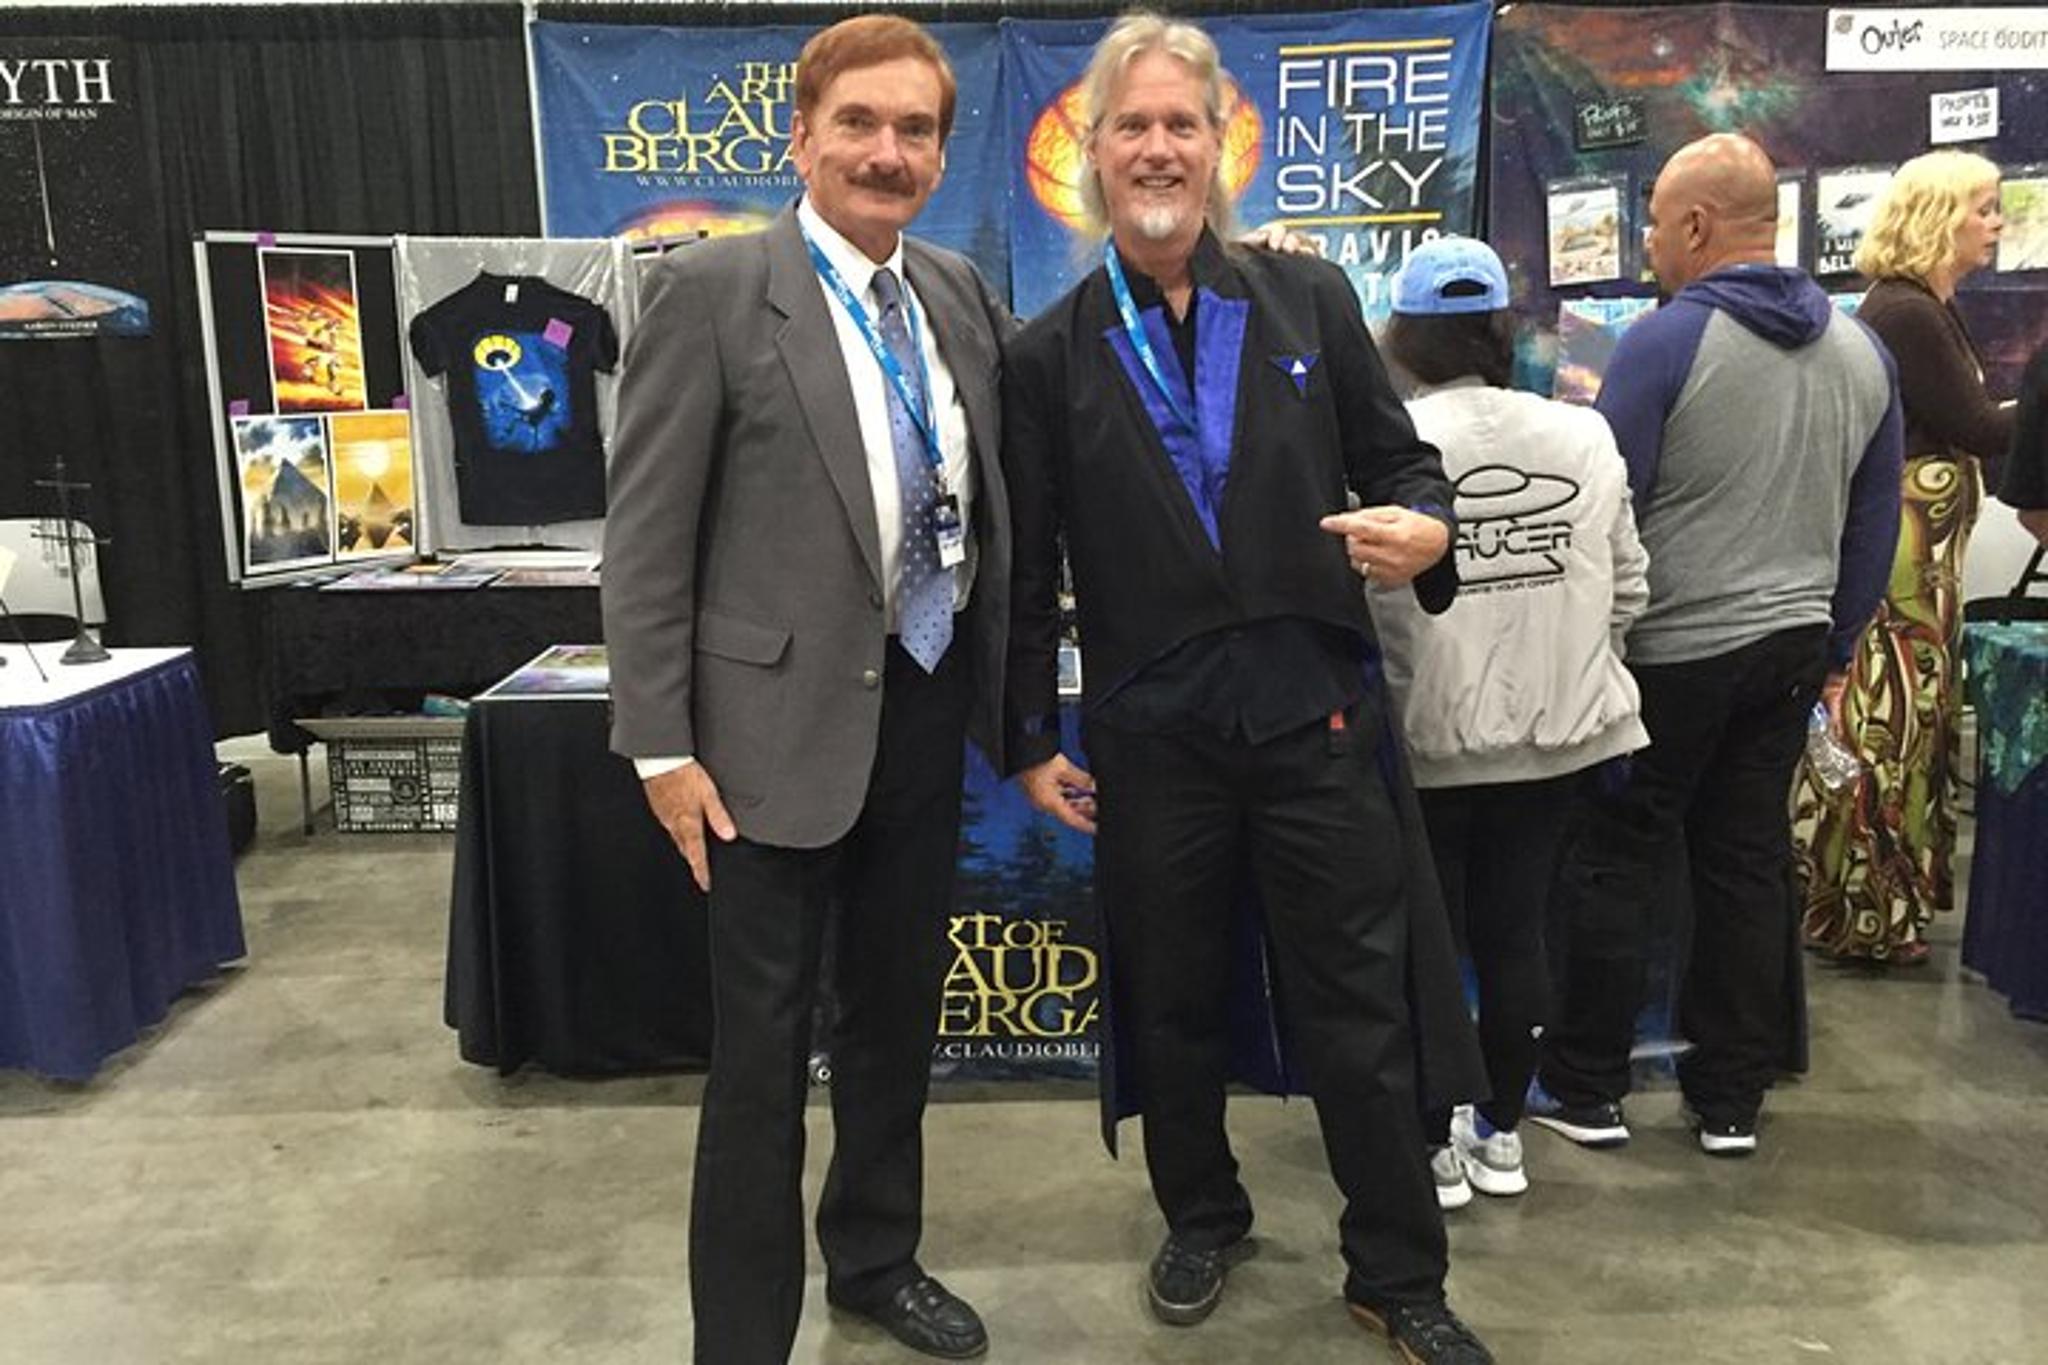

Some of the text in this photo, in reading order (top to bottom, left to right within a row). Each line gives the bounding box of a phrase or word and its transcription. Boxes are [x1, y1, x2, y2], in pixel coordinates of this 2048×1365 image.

[1940, 30, 1989, 50] SPACE
[1279, 52, 1451, 109] FIRE
[0, 107, 43, 119] RIGIN
[1277, 107, 1449, 157] IN THE
[1276, 157, 1443, 212] SKY
[1002, 917, 1069, 950] OF
